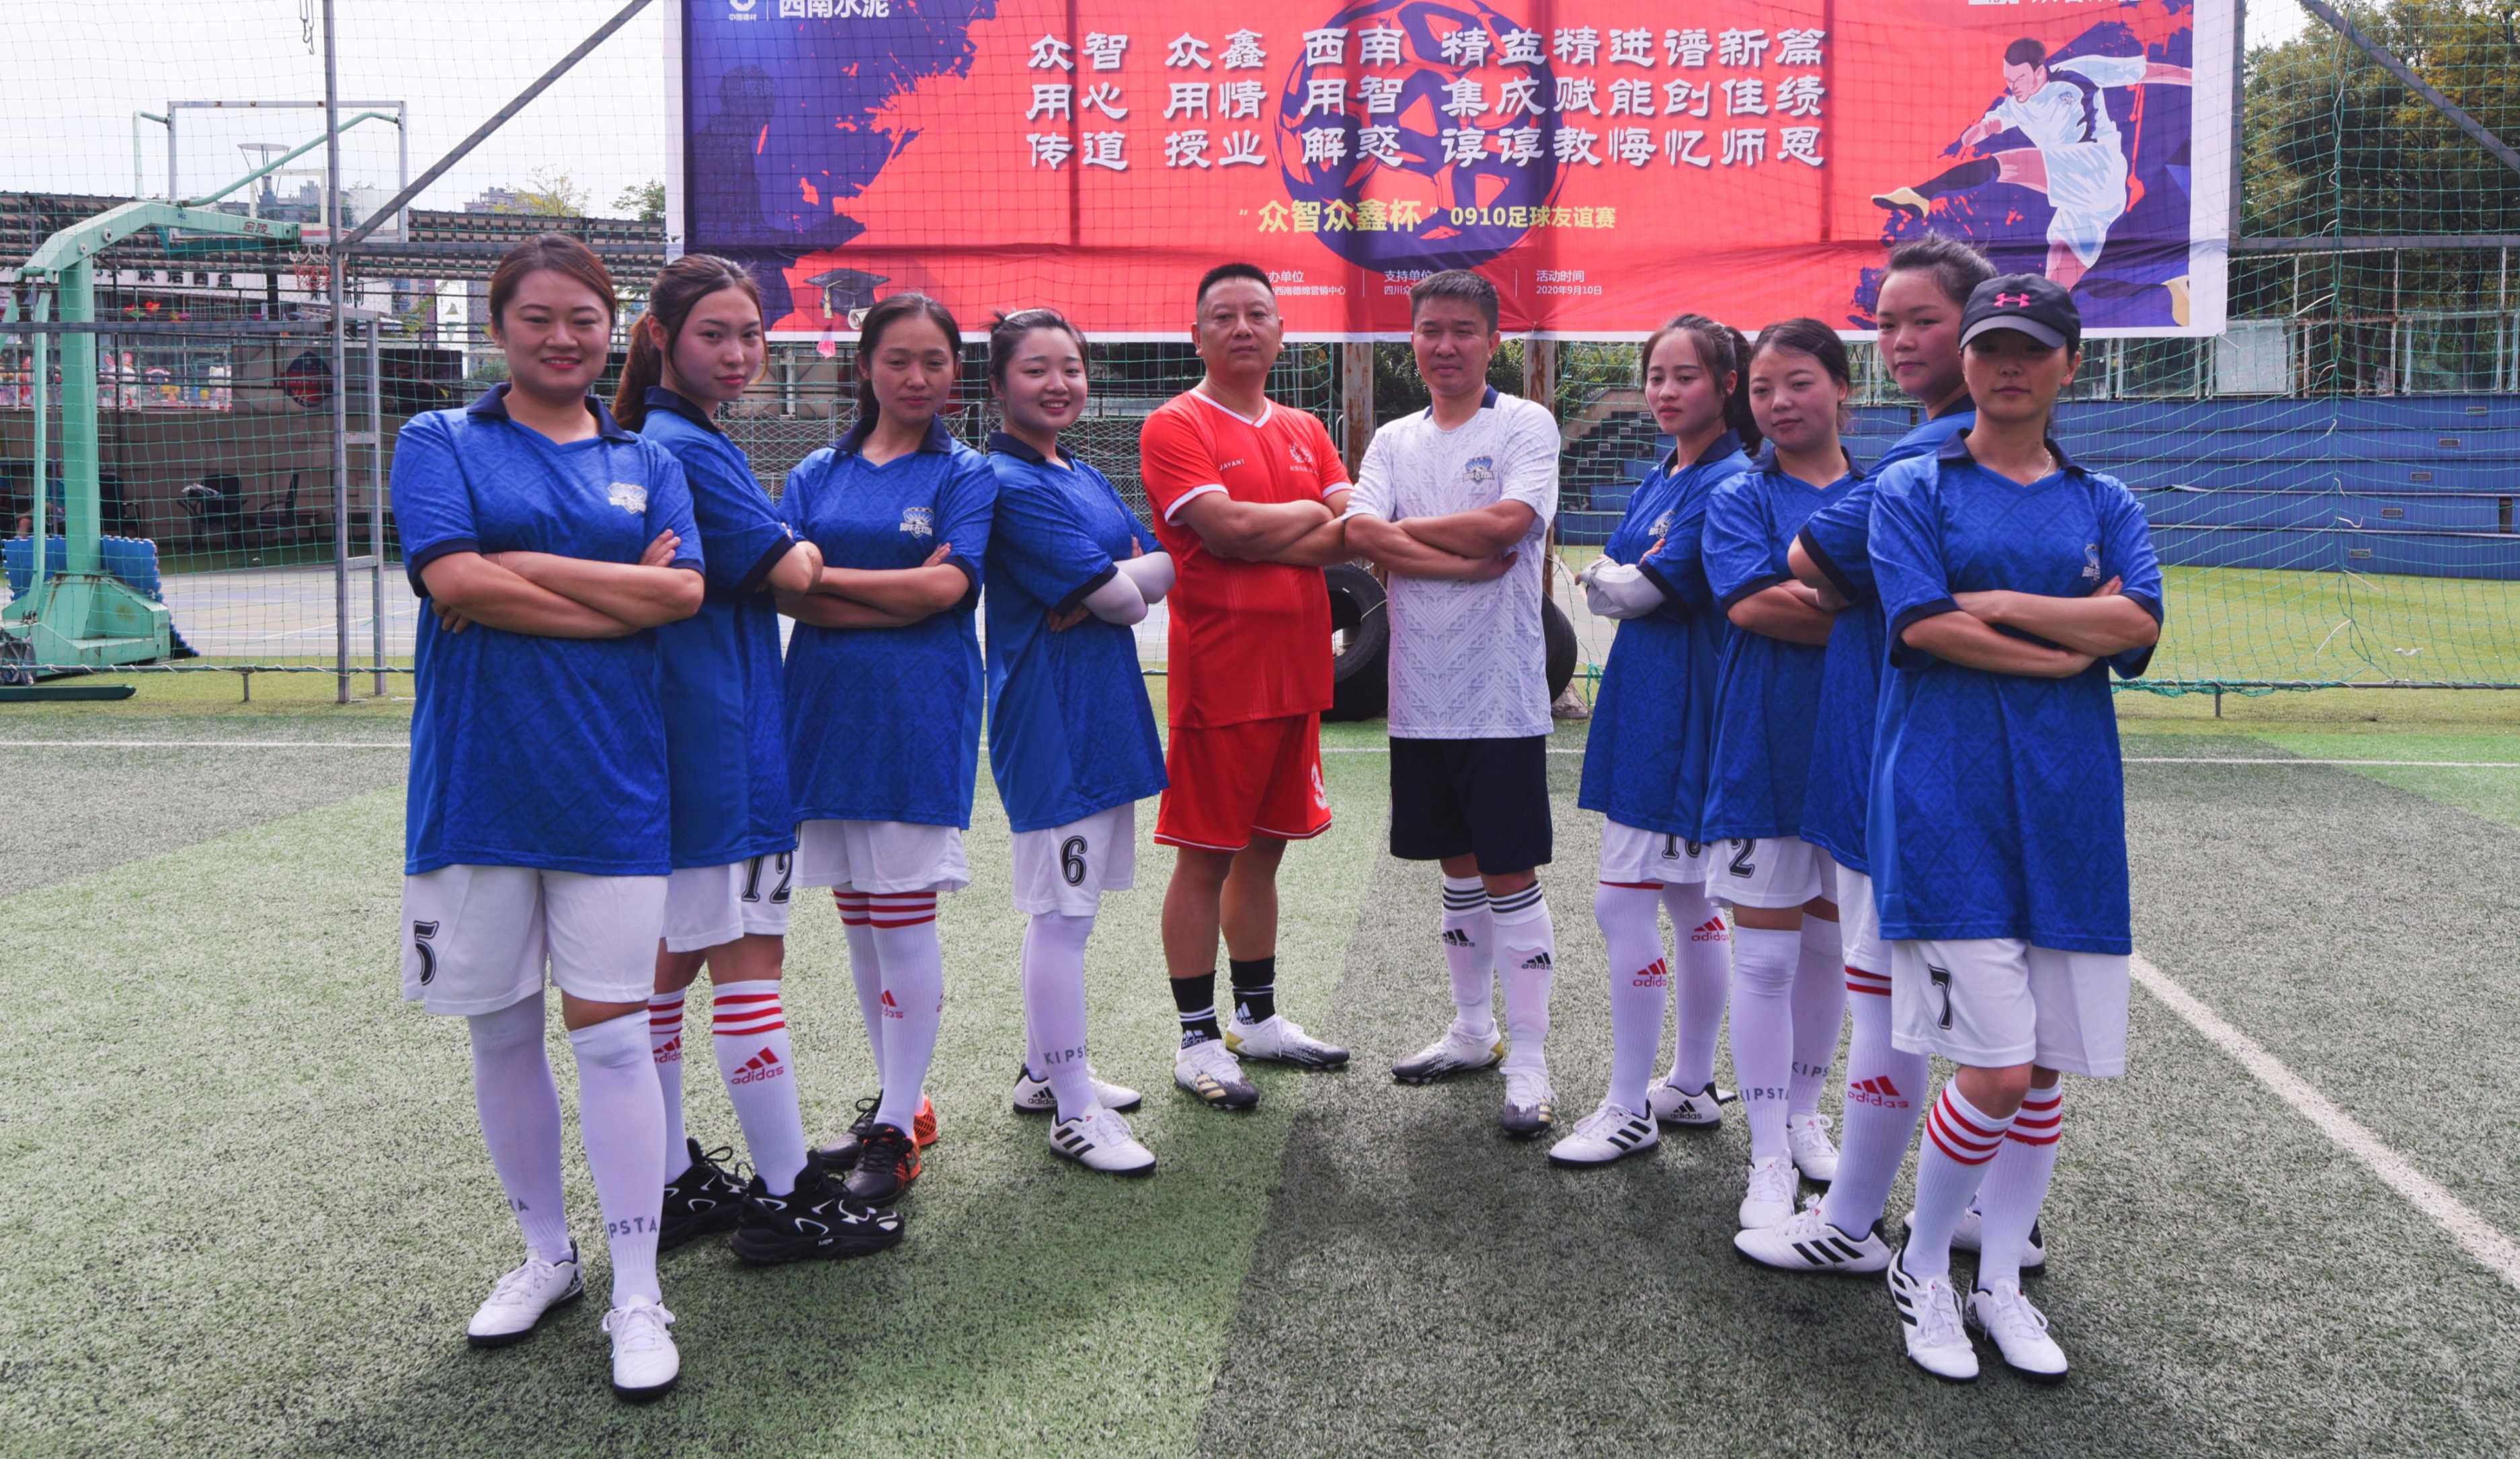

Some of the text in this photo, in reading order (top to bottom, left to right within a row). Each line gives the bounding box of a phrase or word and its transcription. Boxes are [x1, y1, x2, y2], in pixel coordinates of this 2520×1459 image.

[779, 0, 890, 18] 西南水泥
[1027, 24, 1826, 70] 众智 众鑫 西南 精益精进谱新篇
[1026, 75, 1826, 120] 用心 用情 用智 集成赋能创佳绩
[1026, 131, 1128, 170] 传道
[1164, 129, 1266, 168] 授业
[1301, 124, 1404, 167] 解惑
[1451, 206, 1616, 229] 0910足球友谊赛
[1267, 271, 1304, 283] 办单位
[1537, 270, 1585, 282] 活动时间
[1272, 285, 1346, 296] 西南德绵营销中心
[1537, 286, 1602, 296] 2020年9月10日
[1060, 835, 1088, 887] 6
[741, 850, 793, 904] 12
[413, 920, 440, 986] 5
[1927, 963, 1953, 1030] 7
[731, 1066, 784, 1085] adidas
[1847, 1090, 1910, 1109] adidas
